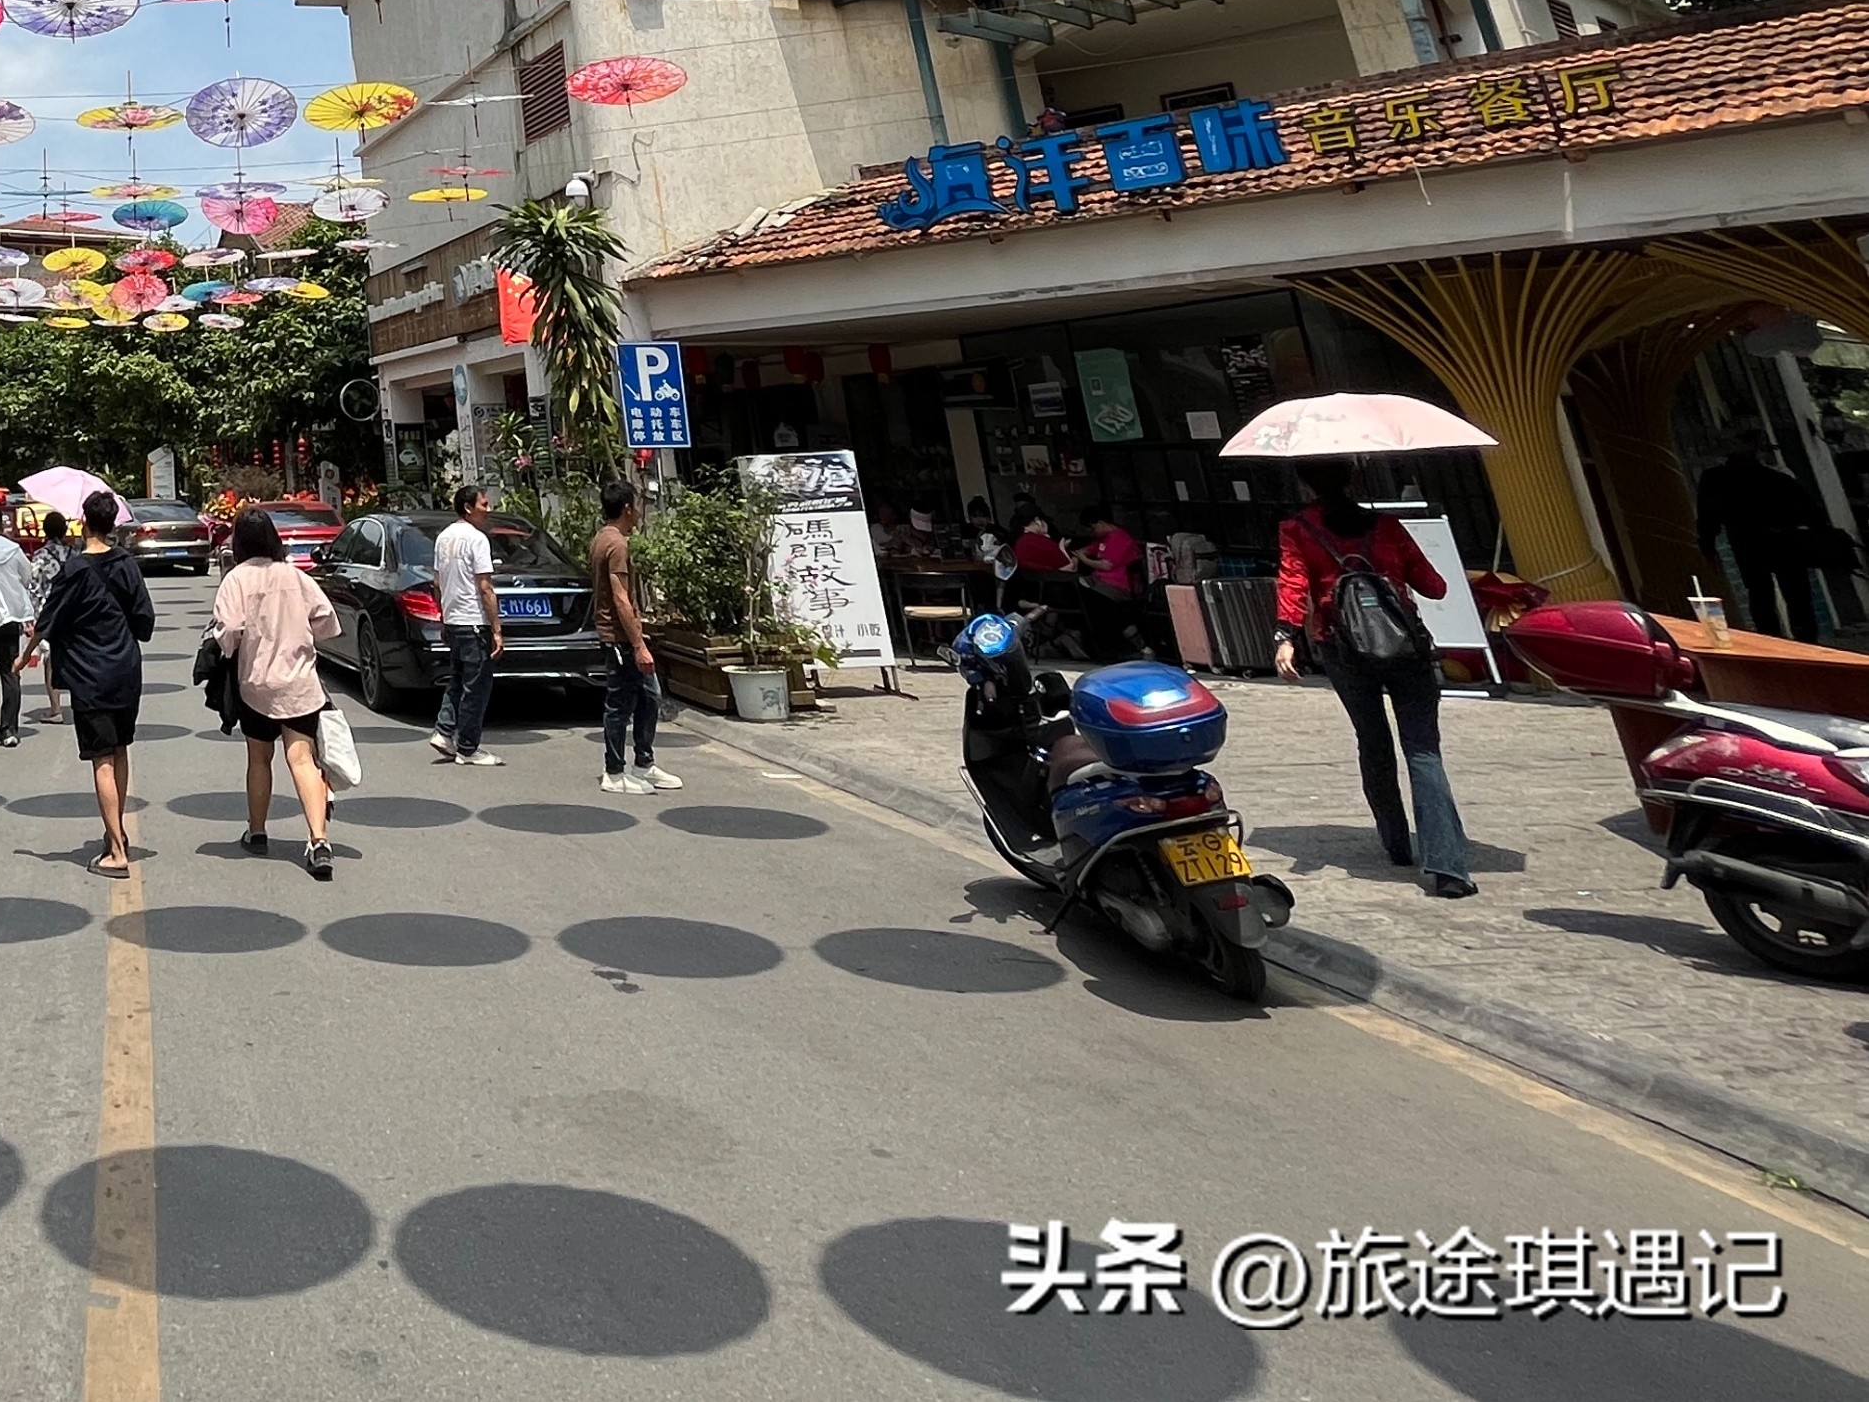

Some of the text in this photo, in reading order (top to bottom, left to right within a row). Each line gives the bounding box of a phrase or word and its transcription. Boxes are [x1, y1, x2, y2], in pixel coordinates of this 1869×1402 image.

[877, 62, 1623, 230] 海洋百味 音乐餐厅
[635, 347, 669, 401] P
[631, 407, 681, 418] 电动车
